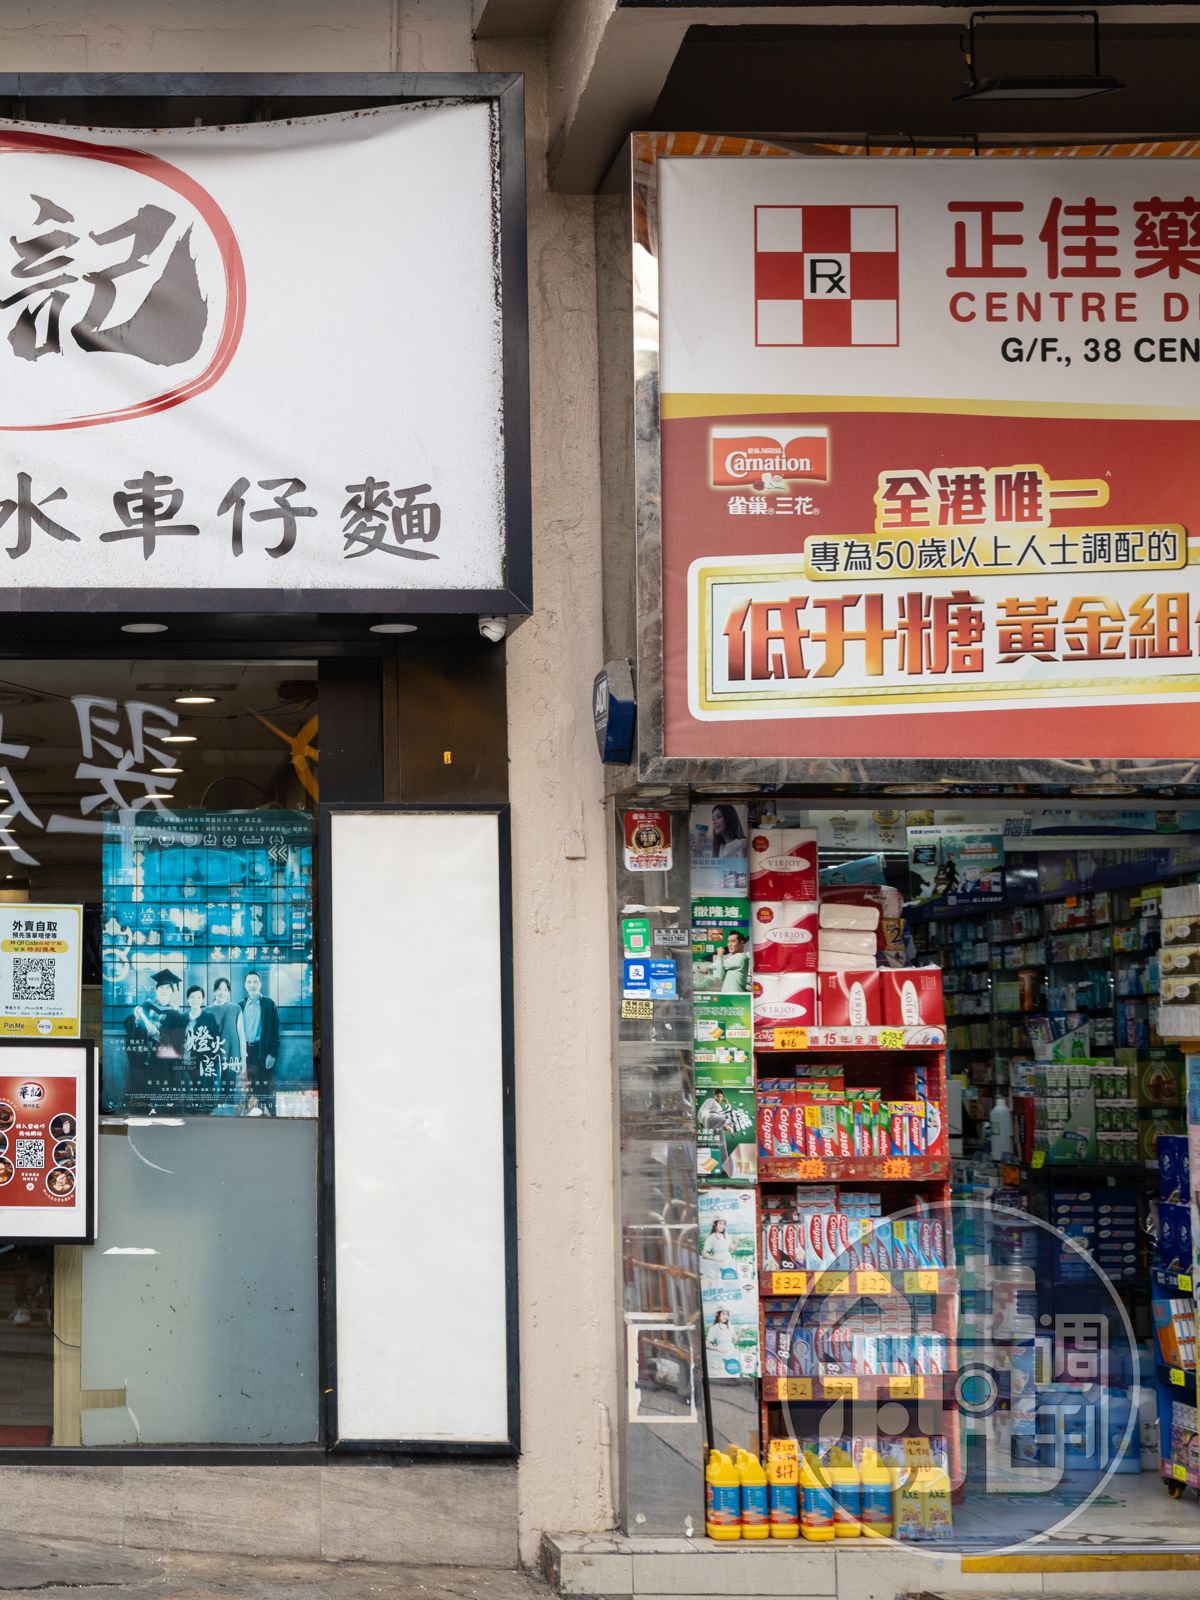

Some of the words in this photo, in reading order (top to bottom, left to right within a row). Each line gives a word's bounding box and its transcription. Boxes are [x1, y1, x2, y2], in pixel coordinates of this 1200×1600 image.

[946, 196, 1200, 280] 正佳藥
[949, 291, 1138, 323] CENTRE
[1163, 292, 1200, 323] D
[1001, 337, 1071, 367] G/F.,
[1083, 337, 1122, 363] 38
[1133, 337, 1200, 363] CEN
[725, 450, 812, 478] Carnation
[881, 469, 1100, 529] 全港唯一
[809, 529, 1178, 573] 專為50歲以上人士調配的
[767, 859, 801, 867] VIRJOY
[12, 920, 58, 932] 外賣自取
[772, 931, 805, 939] VIRJOY
[19, 1085, 43, 1099] 華記
[762, 1108, 772, 1151] Colgate
[794, 1107, 804, 1148] Colgate
[894, 1116, 902, 1147] Colgate
[913, 1116, 921, 1147] Colgate
[771, 1226, 780, 1256] Colgate
[787, 1226, 795, 1258] Colgate
[812, 1215, 822, 1251] Colgate
[922, 1222, 931, 1257] Colgate
[934, 1221, 943, 1256] Colgate
[774, 1276, 802, 1290] $32
[776, 1464, 795, 1479] $17
[902, 1489, 919, 1499] AXE
[928, 1489, 946, 1499] AXE
